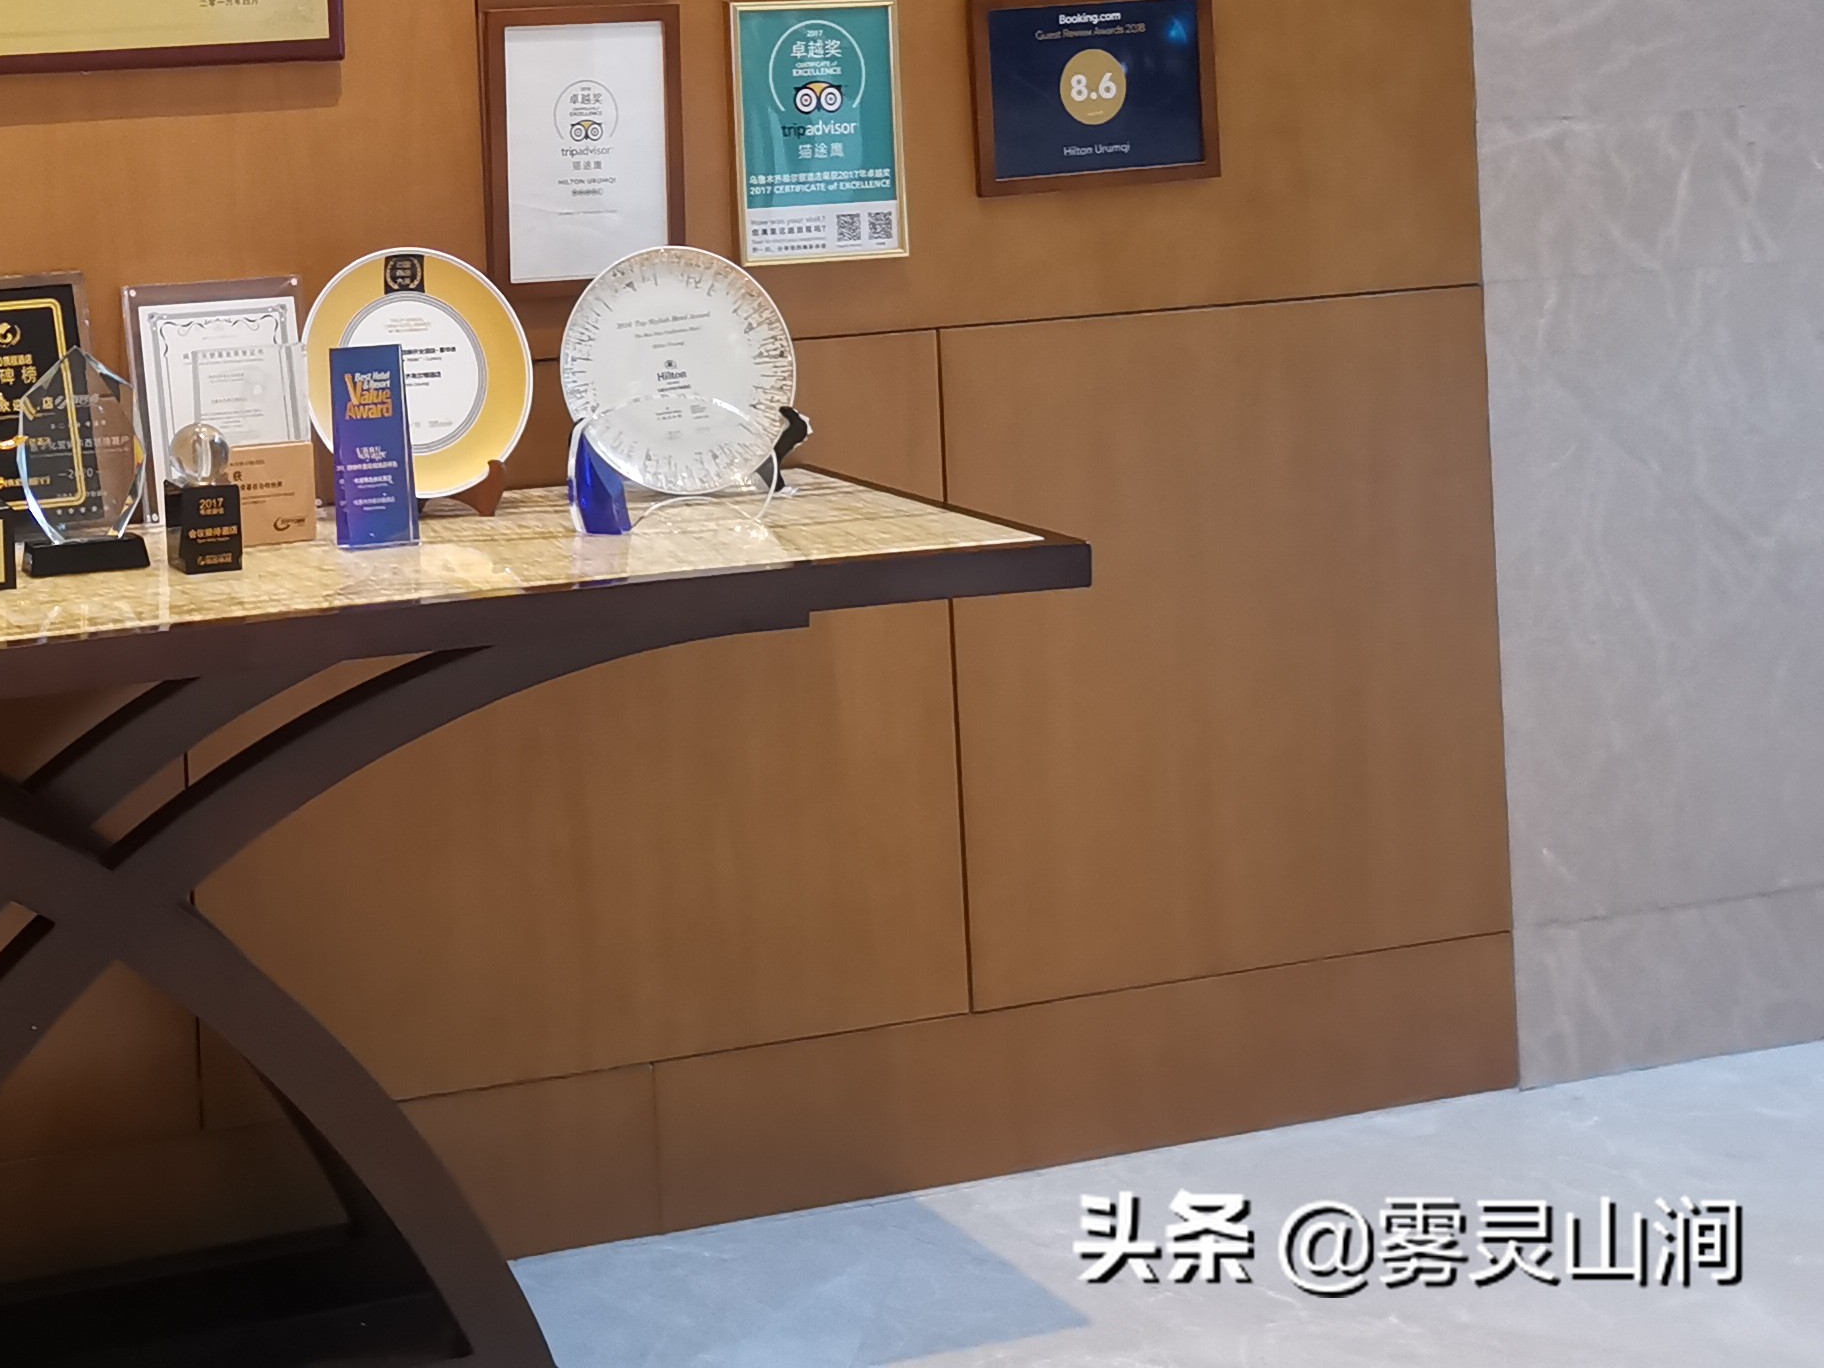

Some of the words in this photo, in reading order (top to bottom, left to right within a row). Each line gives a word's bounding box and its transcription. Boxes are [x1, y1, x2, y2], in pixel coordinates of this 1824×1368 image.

[1058, 11, 1122, 25] Booking.com
[1035, 30, 1062, 40] Guest
[1062, 28, 1093, 39] Review
[1094, 26, 1124, 37] Awards
[790, 40, 843, 60] 卓越奖
[792, 66, 842, 77] EXCELLENCE
[1070, 72, 1117, 102] 8.6
[569, 93, 603, 105] 卓越奖
[781, 119, 857, 139] tripadvisor
[560, 145, 612, 159] tripadvisor
[797, 142, 845, 160] 猫途鹰
[1063, 144, 1093, 157] Hilton
[1095, 141, 1131, 156] Urumqi
[557, 178, 586, 186] HILTON
[586, 177, 617, 185] URUMQI
[749, 186, 772, 195] 2017
[773, 183, 827, 195] CERTIFICATE
[827, 182, 839, 191] of
[839, 179, 892, 191] EXCELLENCE
[354, 372, 371, 382] Best
[372, 370, 390, 381] Hotel
[657, 370, 688, 381] Hilton
[344, 373, 392, 406] Value
[344, 398, 393, 420] Award
[199, 497, 224, 508] 2017
